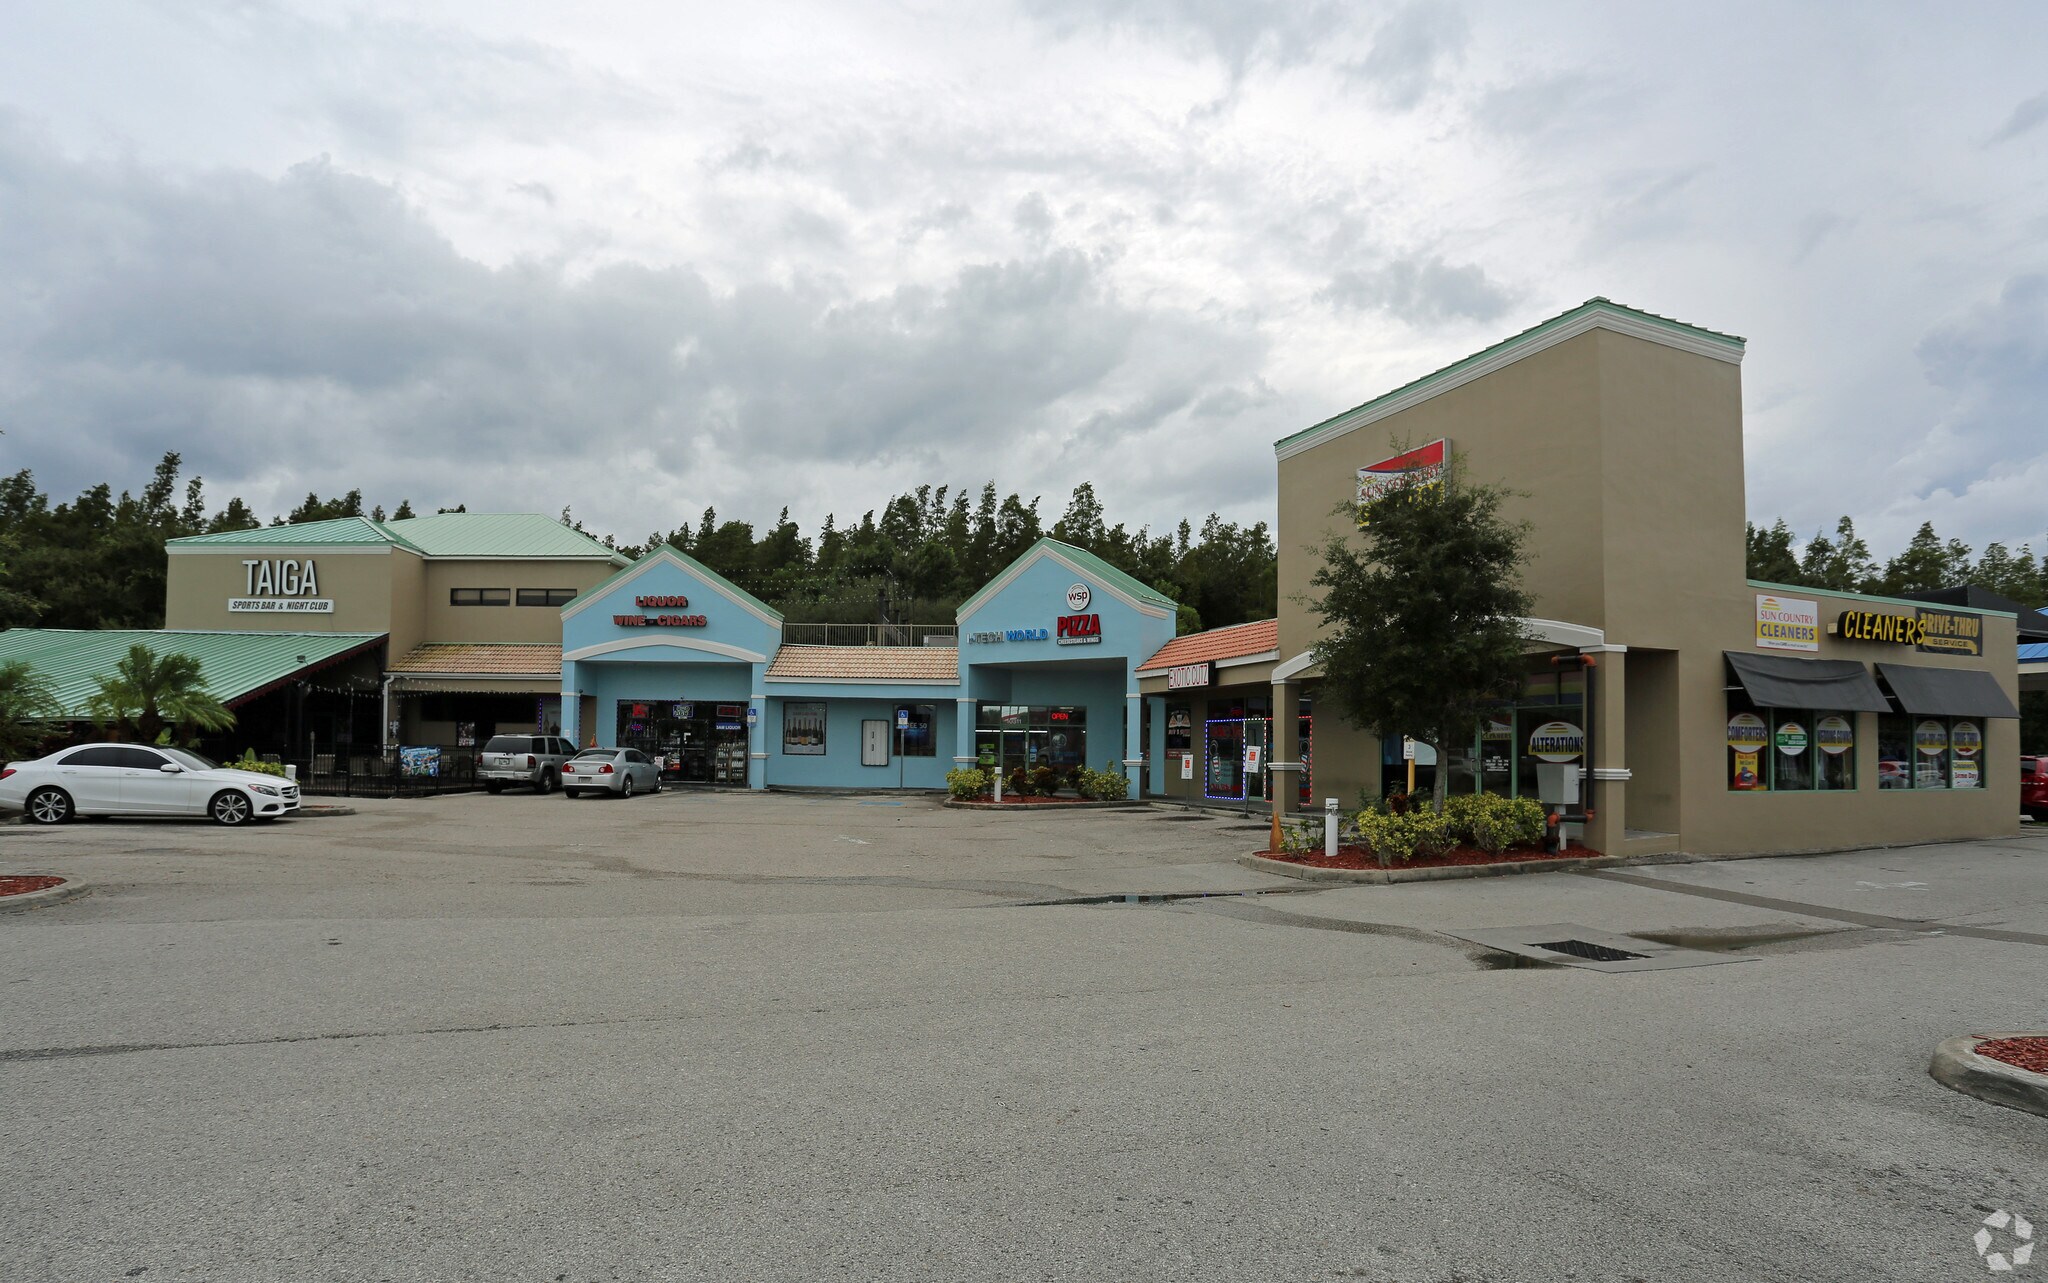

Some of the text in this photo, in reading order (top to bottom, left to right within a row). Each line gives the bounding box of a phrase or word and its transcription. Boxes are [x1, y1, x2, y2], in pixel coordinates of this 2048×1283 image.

[242, 559, 317, 595] TAIGA
[635, 596, 687, 607] LIQUOR
[1068, 591, 1087, 601] wsp
[232, 601, 260, 609] SPORTS
[261, 601, 276, 609] BAR
[286, 602, 309, 610] NIGHT
[309, 602, 328, 610] CLUB
[613, 615, 646, 626] WINE
[657, 615, 707, 626] CIGARS
[1761, 610, 1814, 624] SUN COUNTRY
[1057, 614, 1101, 637] PIZZA
[1761, 623, 1814, 640] CLEANERS
[1845, 610, 1925, 645] CLEANERS
[1920, 613, 1979, 637] DRIVE-THRU
[1005, 629, 1048, 641] WORLD
[1933, 639, 1968, 647] SERVICE
